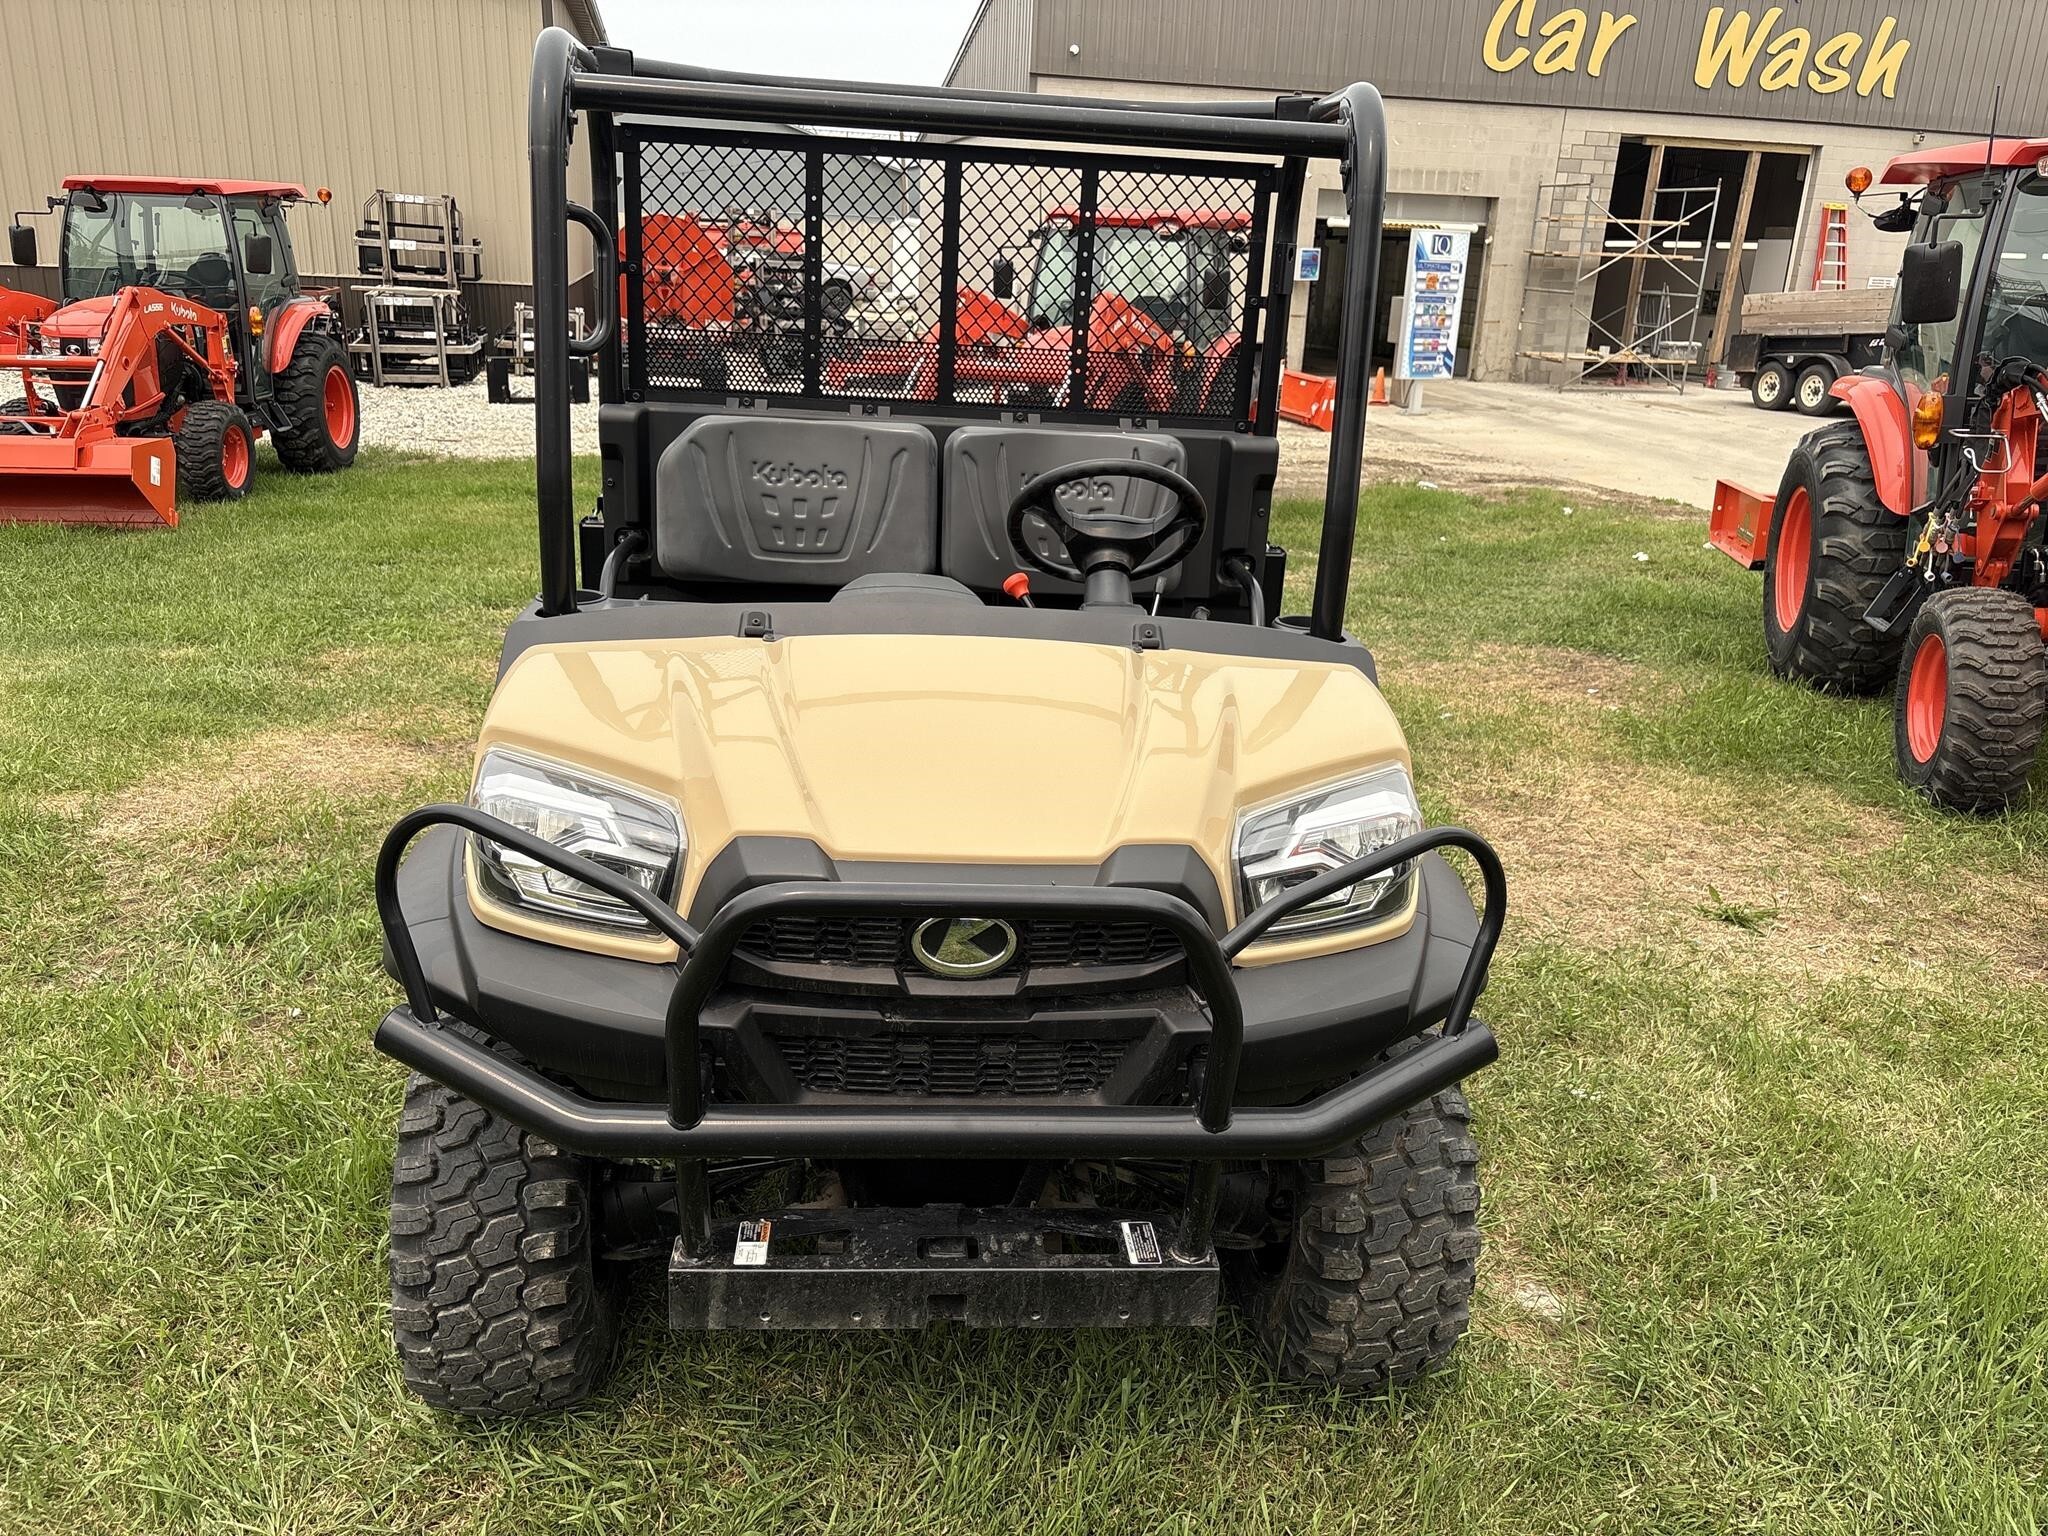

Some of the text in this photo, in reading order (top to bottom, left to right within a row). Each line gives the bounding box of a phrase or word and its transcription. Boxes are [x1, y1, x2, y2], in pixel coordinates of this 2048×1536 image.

[1482, 0, 1911, 99] Car Wash
[1433, 236, 1450, 256] IQ
[170, 301, 198, 322] Kubota
[751, 460, 848, 489] Kubota
